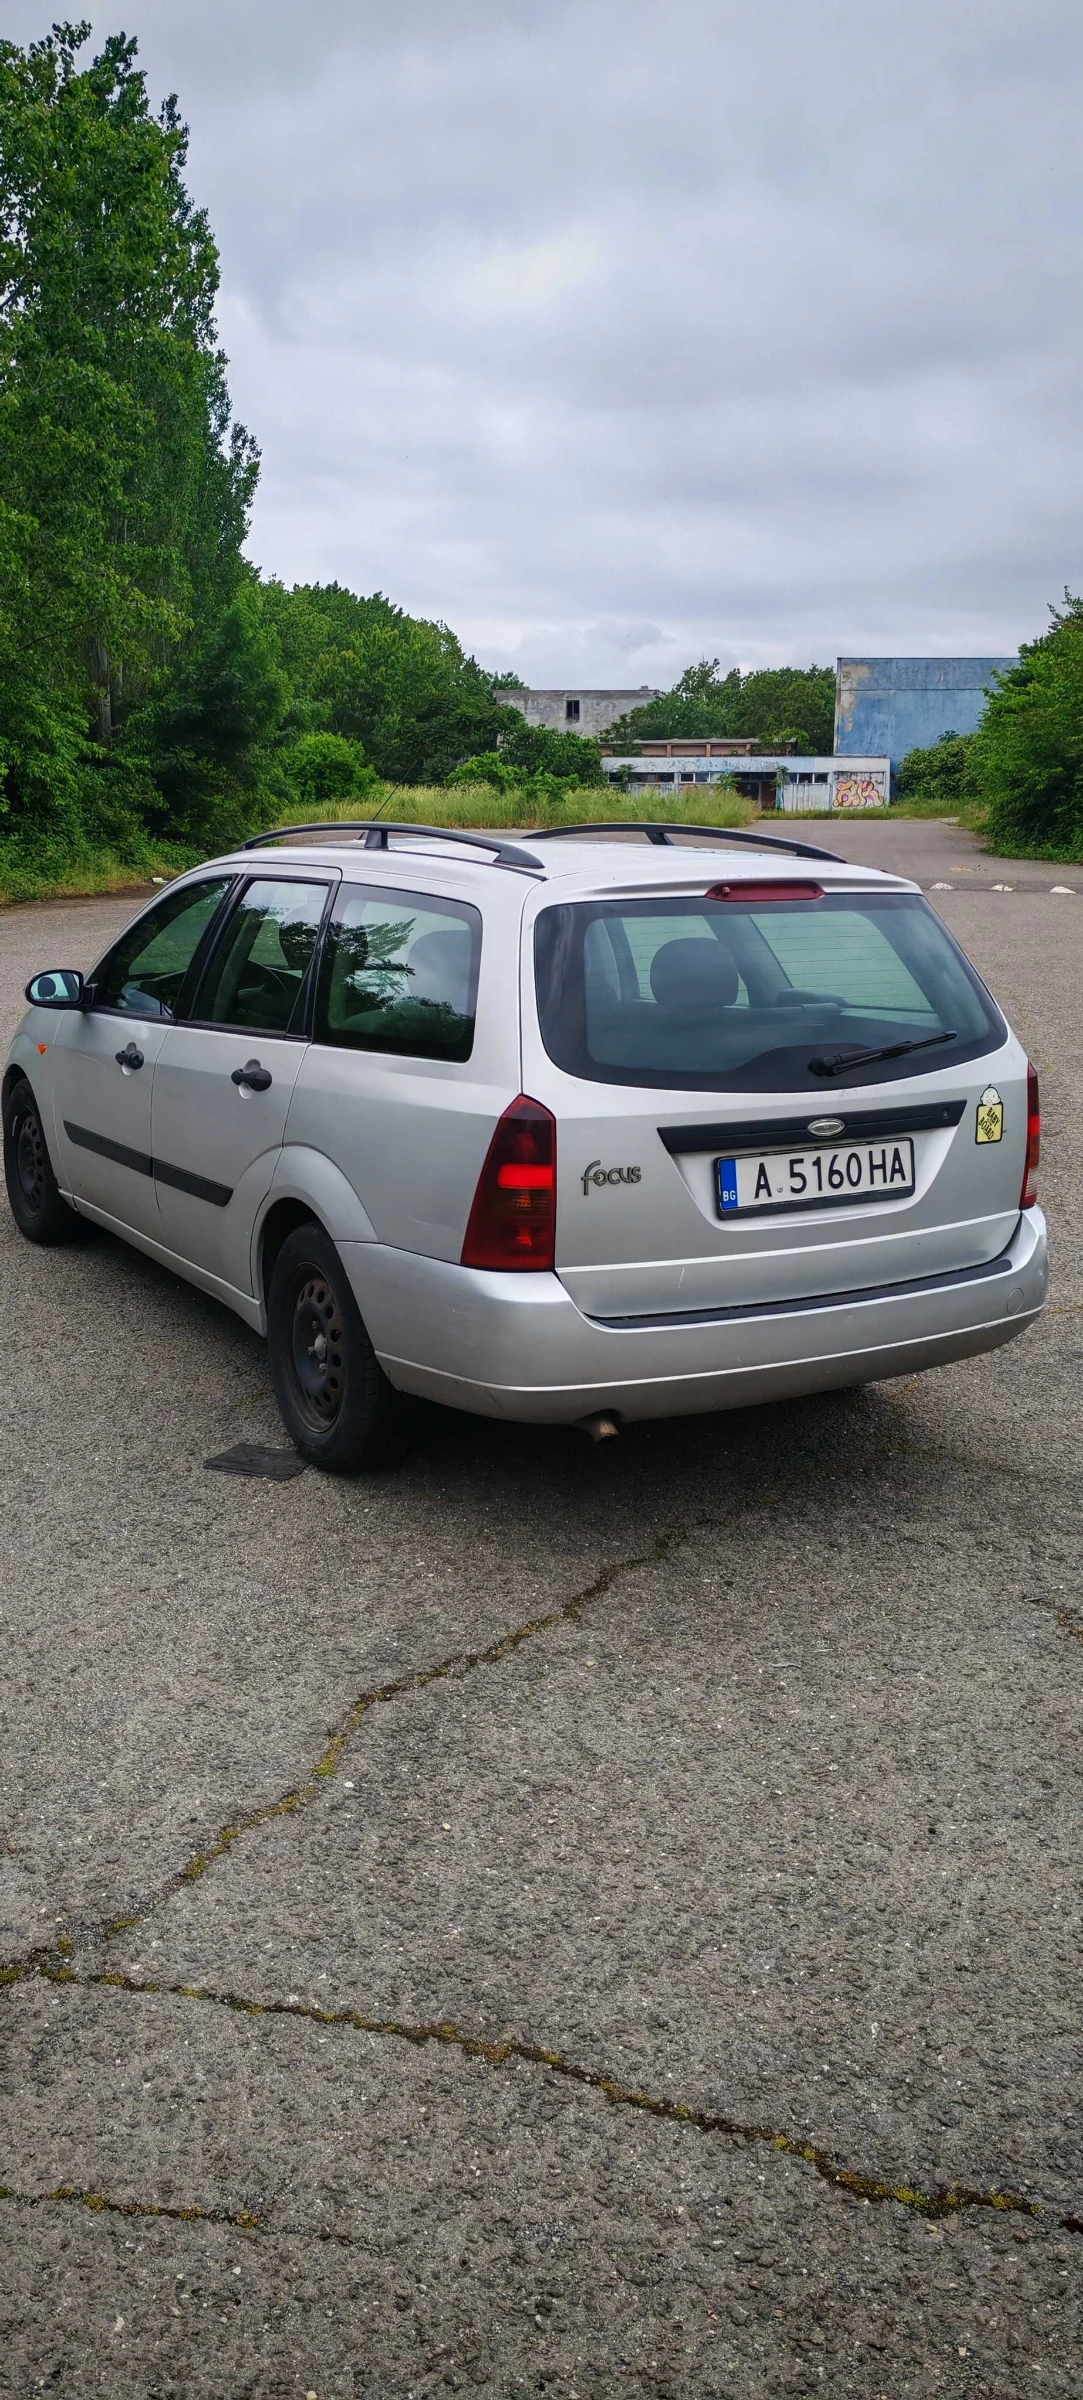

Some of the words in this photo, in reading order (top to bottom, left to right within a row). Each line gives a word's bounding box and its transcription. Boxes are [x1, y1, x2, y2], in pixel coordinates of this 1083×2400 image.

[978, 1116, 994, 1140] BOARD
[986, 1107, 1000, 1127] BABY
[754, 1162, 772, 1199] A
[789, 1152, 862, 1194] 5160
[868, 1147, 906, 1185] HA
[722, 1190, 736, 1202] BG
